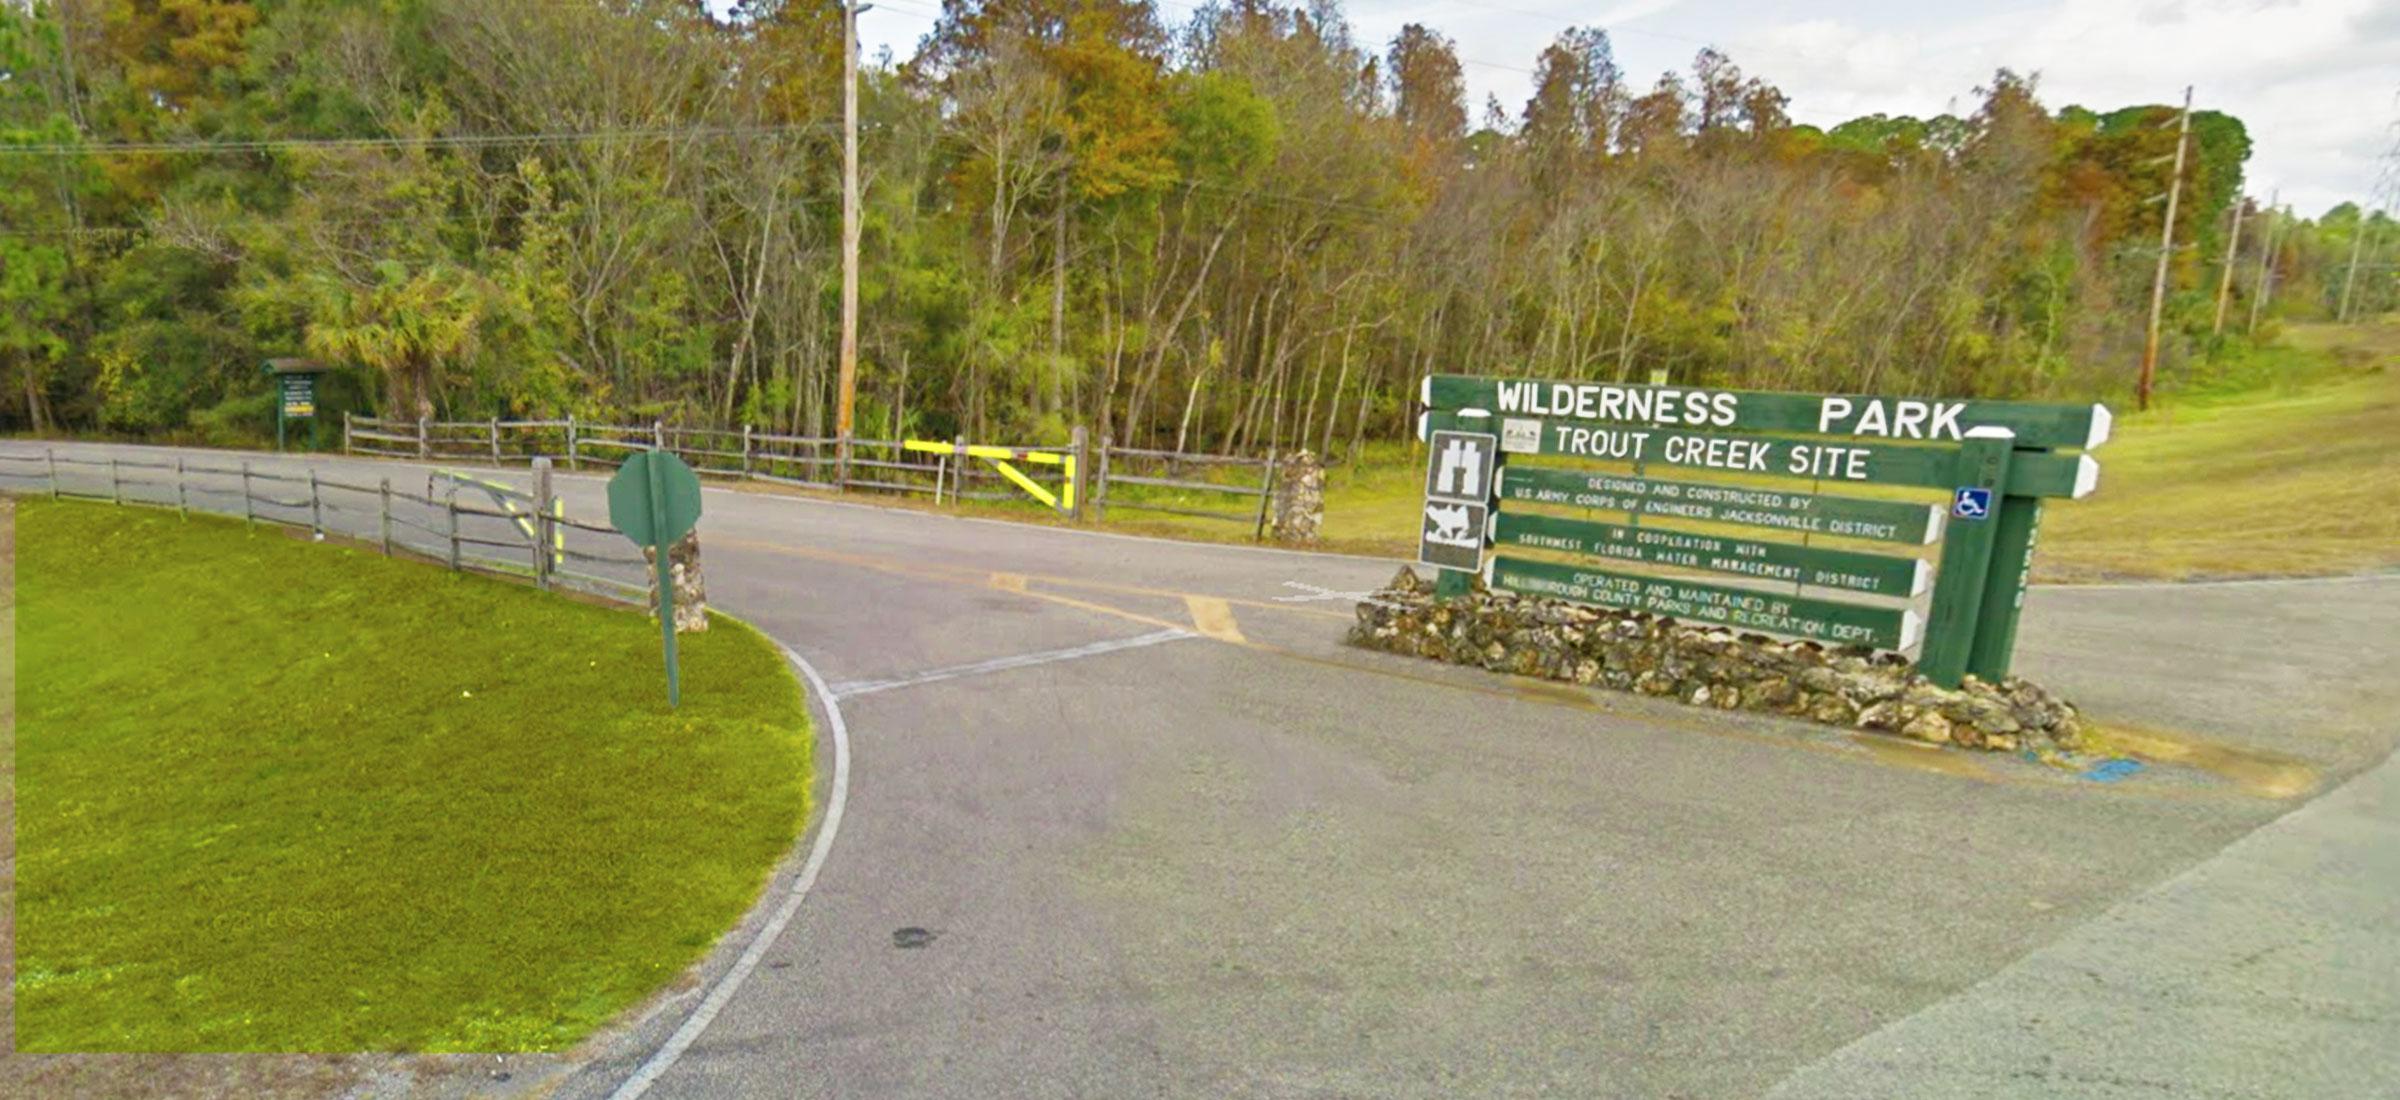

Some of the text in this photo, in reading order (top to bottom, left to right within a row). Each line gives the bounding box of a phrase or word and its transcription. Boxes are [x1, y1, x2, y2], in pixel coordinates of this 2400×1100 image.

[1497, 381, 1967, 440] WILDERNESS PARK
[1556, 426, 1871, 479] TROUT CREEK SITE
[1536, 489, 1569, 504] ARMY
[1575, 493, 1615, 509] CORPS
[1622, 499, 1638, 510] OF
[1645, 500, 1713, 519] ENGINEERS
[1720, 508, 1821, 531] JACKSONVILLE
[1829, 519, 1897, 539] DISTRICT
[1588, 477, 1812, 510] DESIGNED AND CONSTRUCTED BY
[1519, 533, 1880, 590] SOUTHWEST FLORIDA WATER MANAGEMENT DISTRICT
[1612, 527, 1767, 558] IN COOPERATION WITH
[1573, 572, 1792, 616] OPERATED AND MAINTAINED BY
[1592, 585, 1641, 606] COUNTY
[1647, 596, 1691, 615] PARKS
[1698, 606, 1727, 621] AND
[1732, 608, 1825, 635] RECREATION
[1832, 623, 1880, 643] DEPT.
